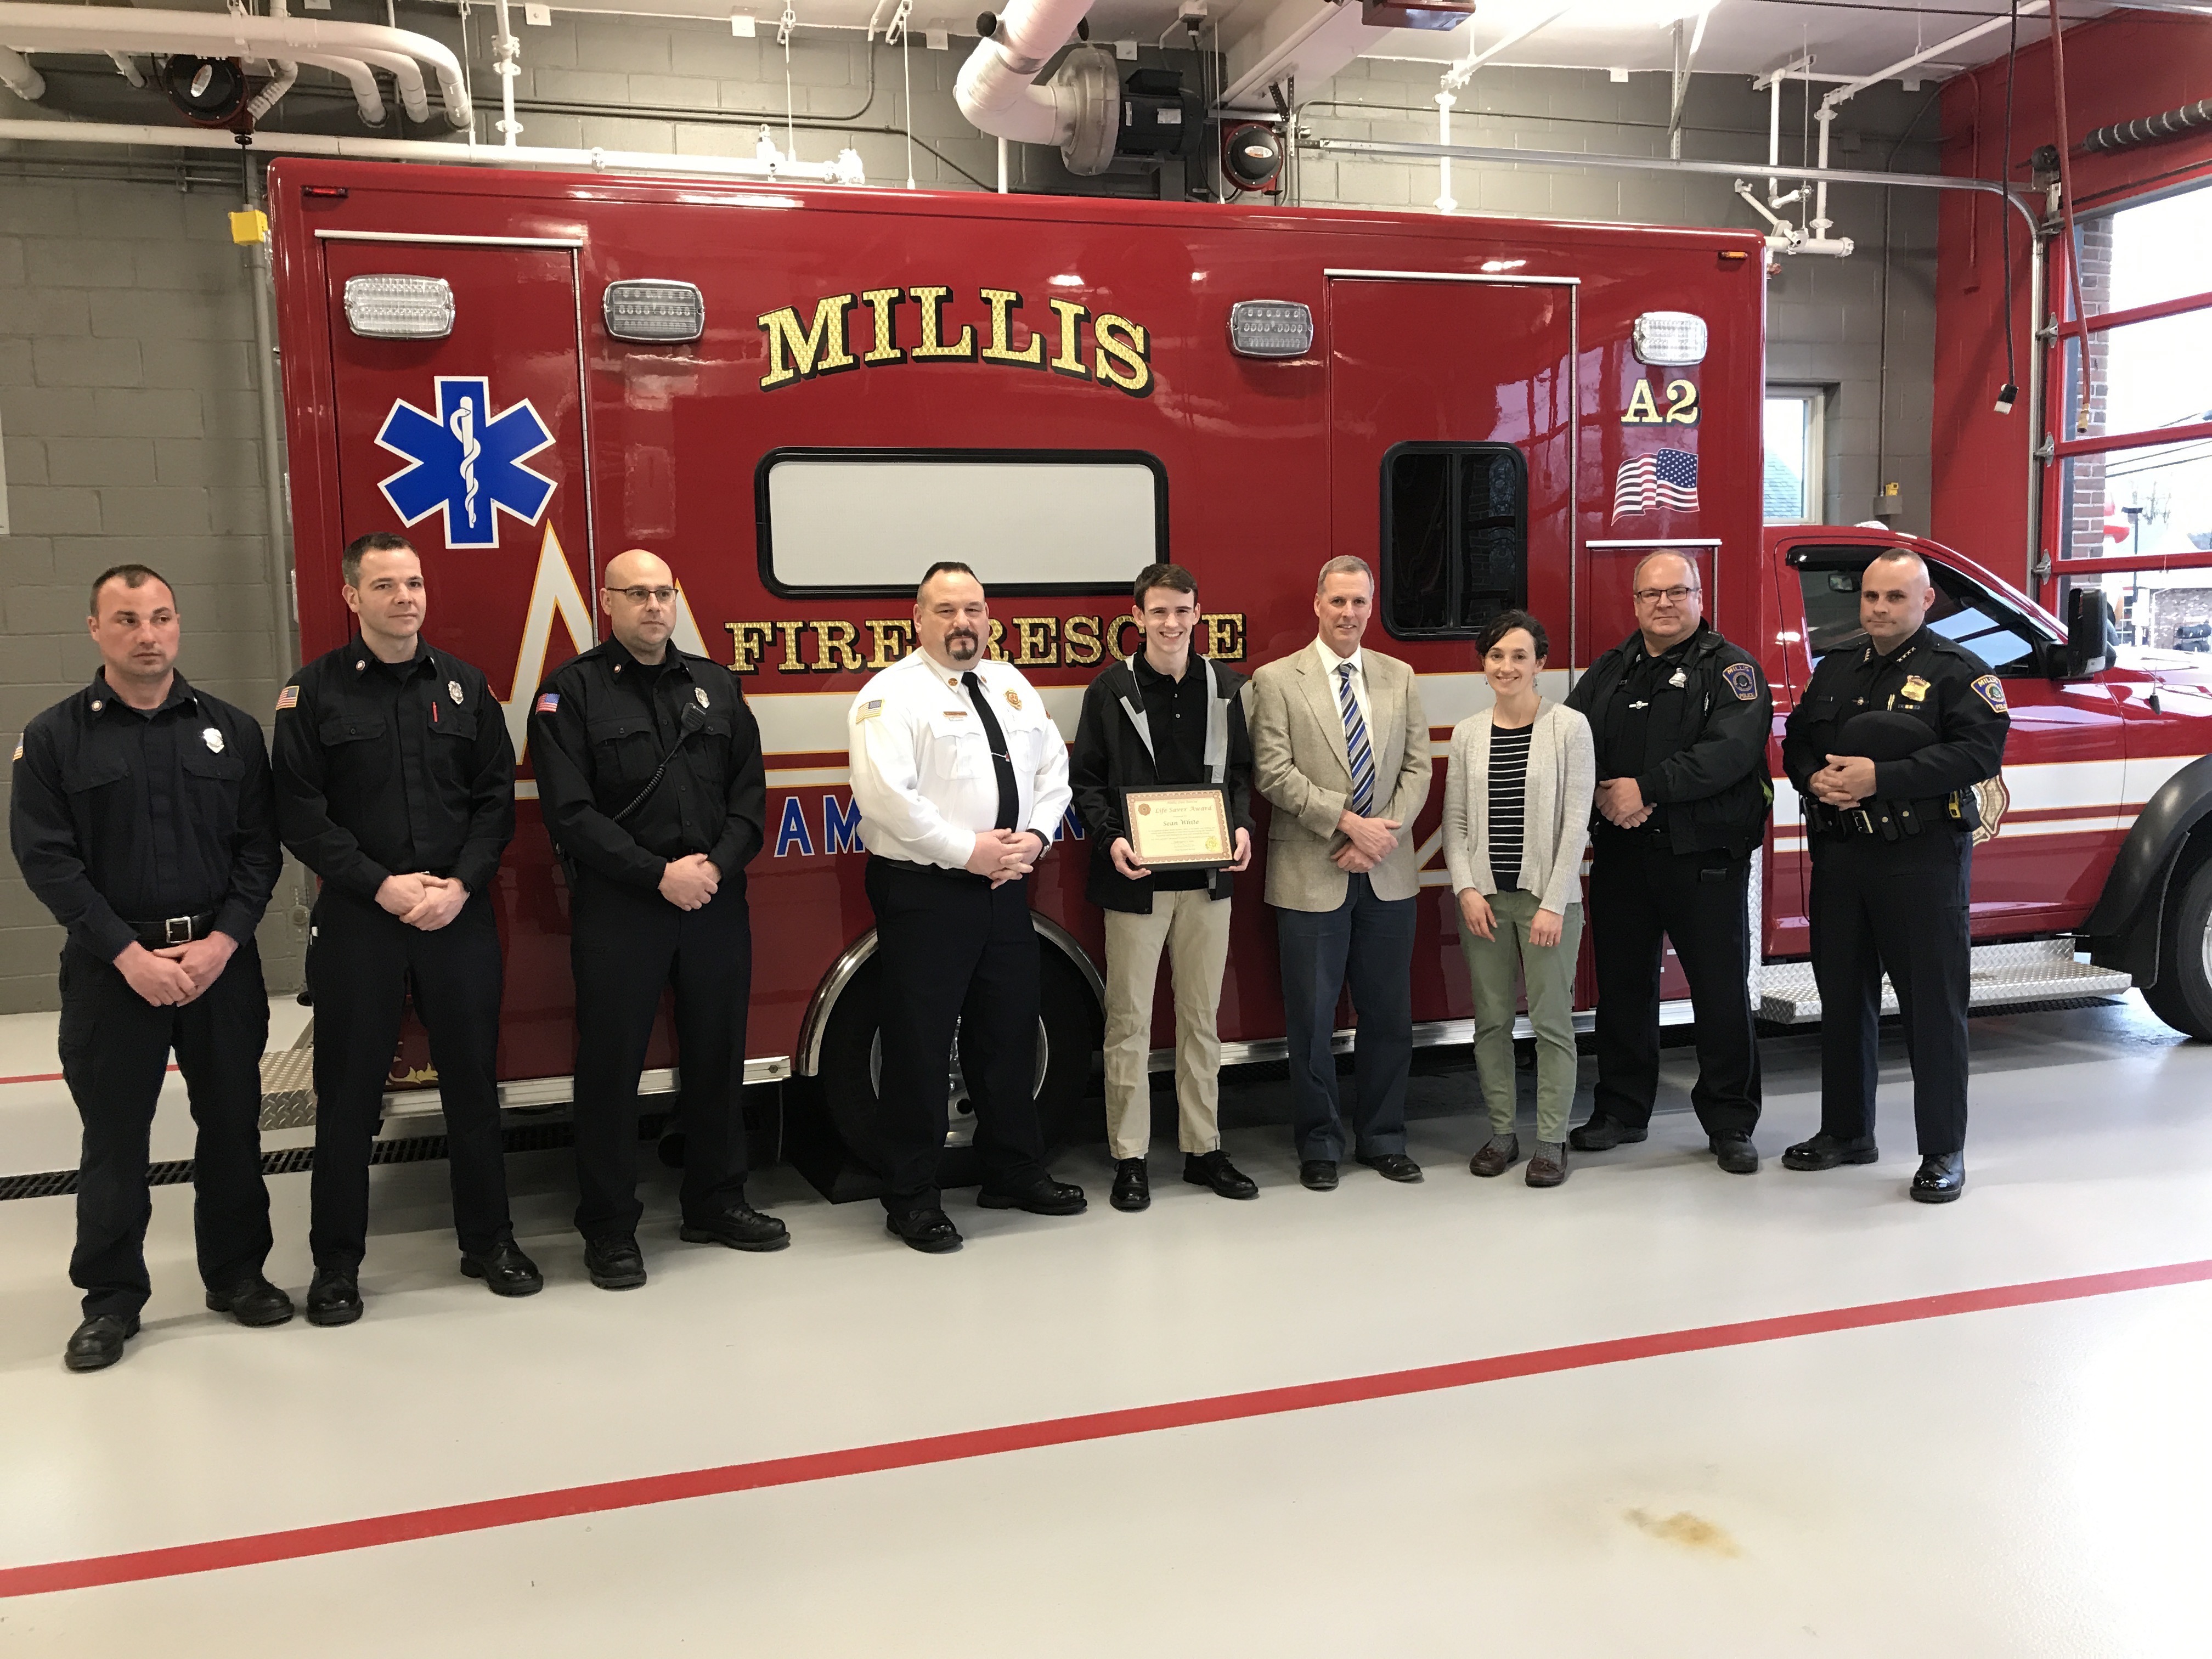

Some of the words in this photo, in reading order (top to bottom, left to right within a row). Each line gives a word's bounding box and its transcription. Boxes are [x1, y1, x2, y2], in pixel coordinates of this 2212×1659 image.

[757, 285, 1153, 397] MILLIS
[1621, 379, 1700, 427] A2
[724, 619, 916, 674] FIRE
[1727, 665, 1750, 675] MILLIS
